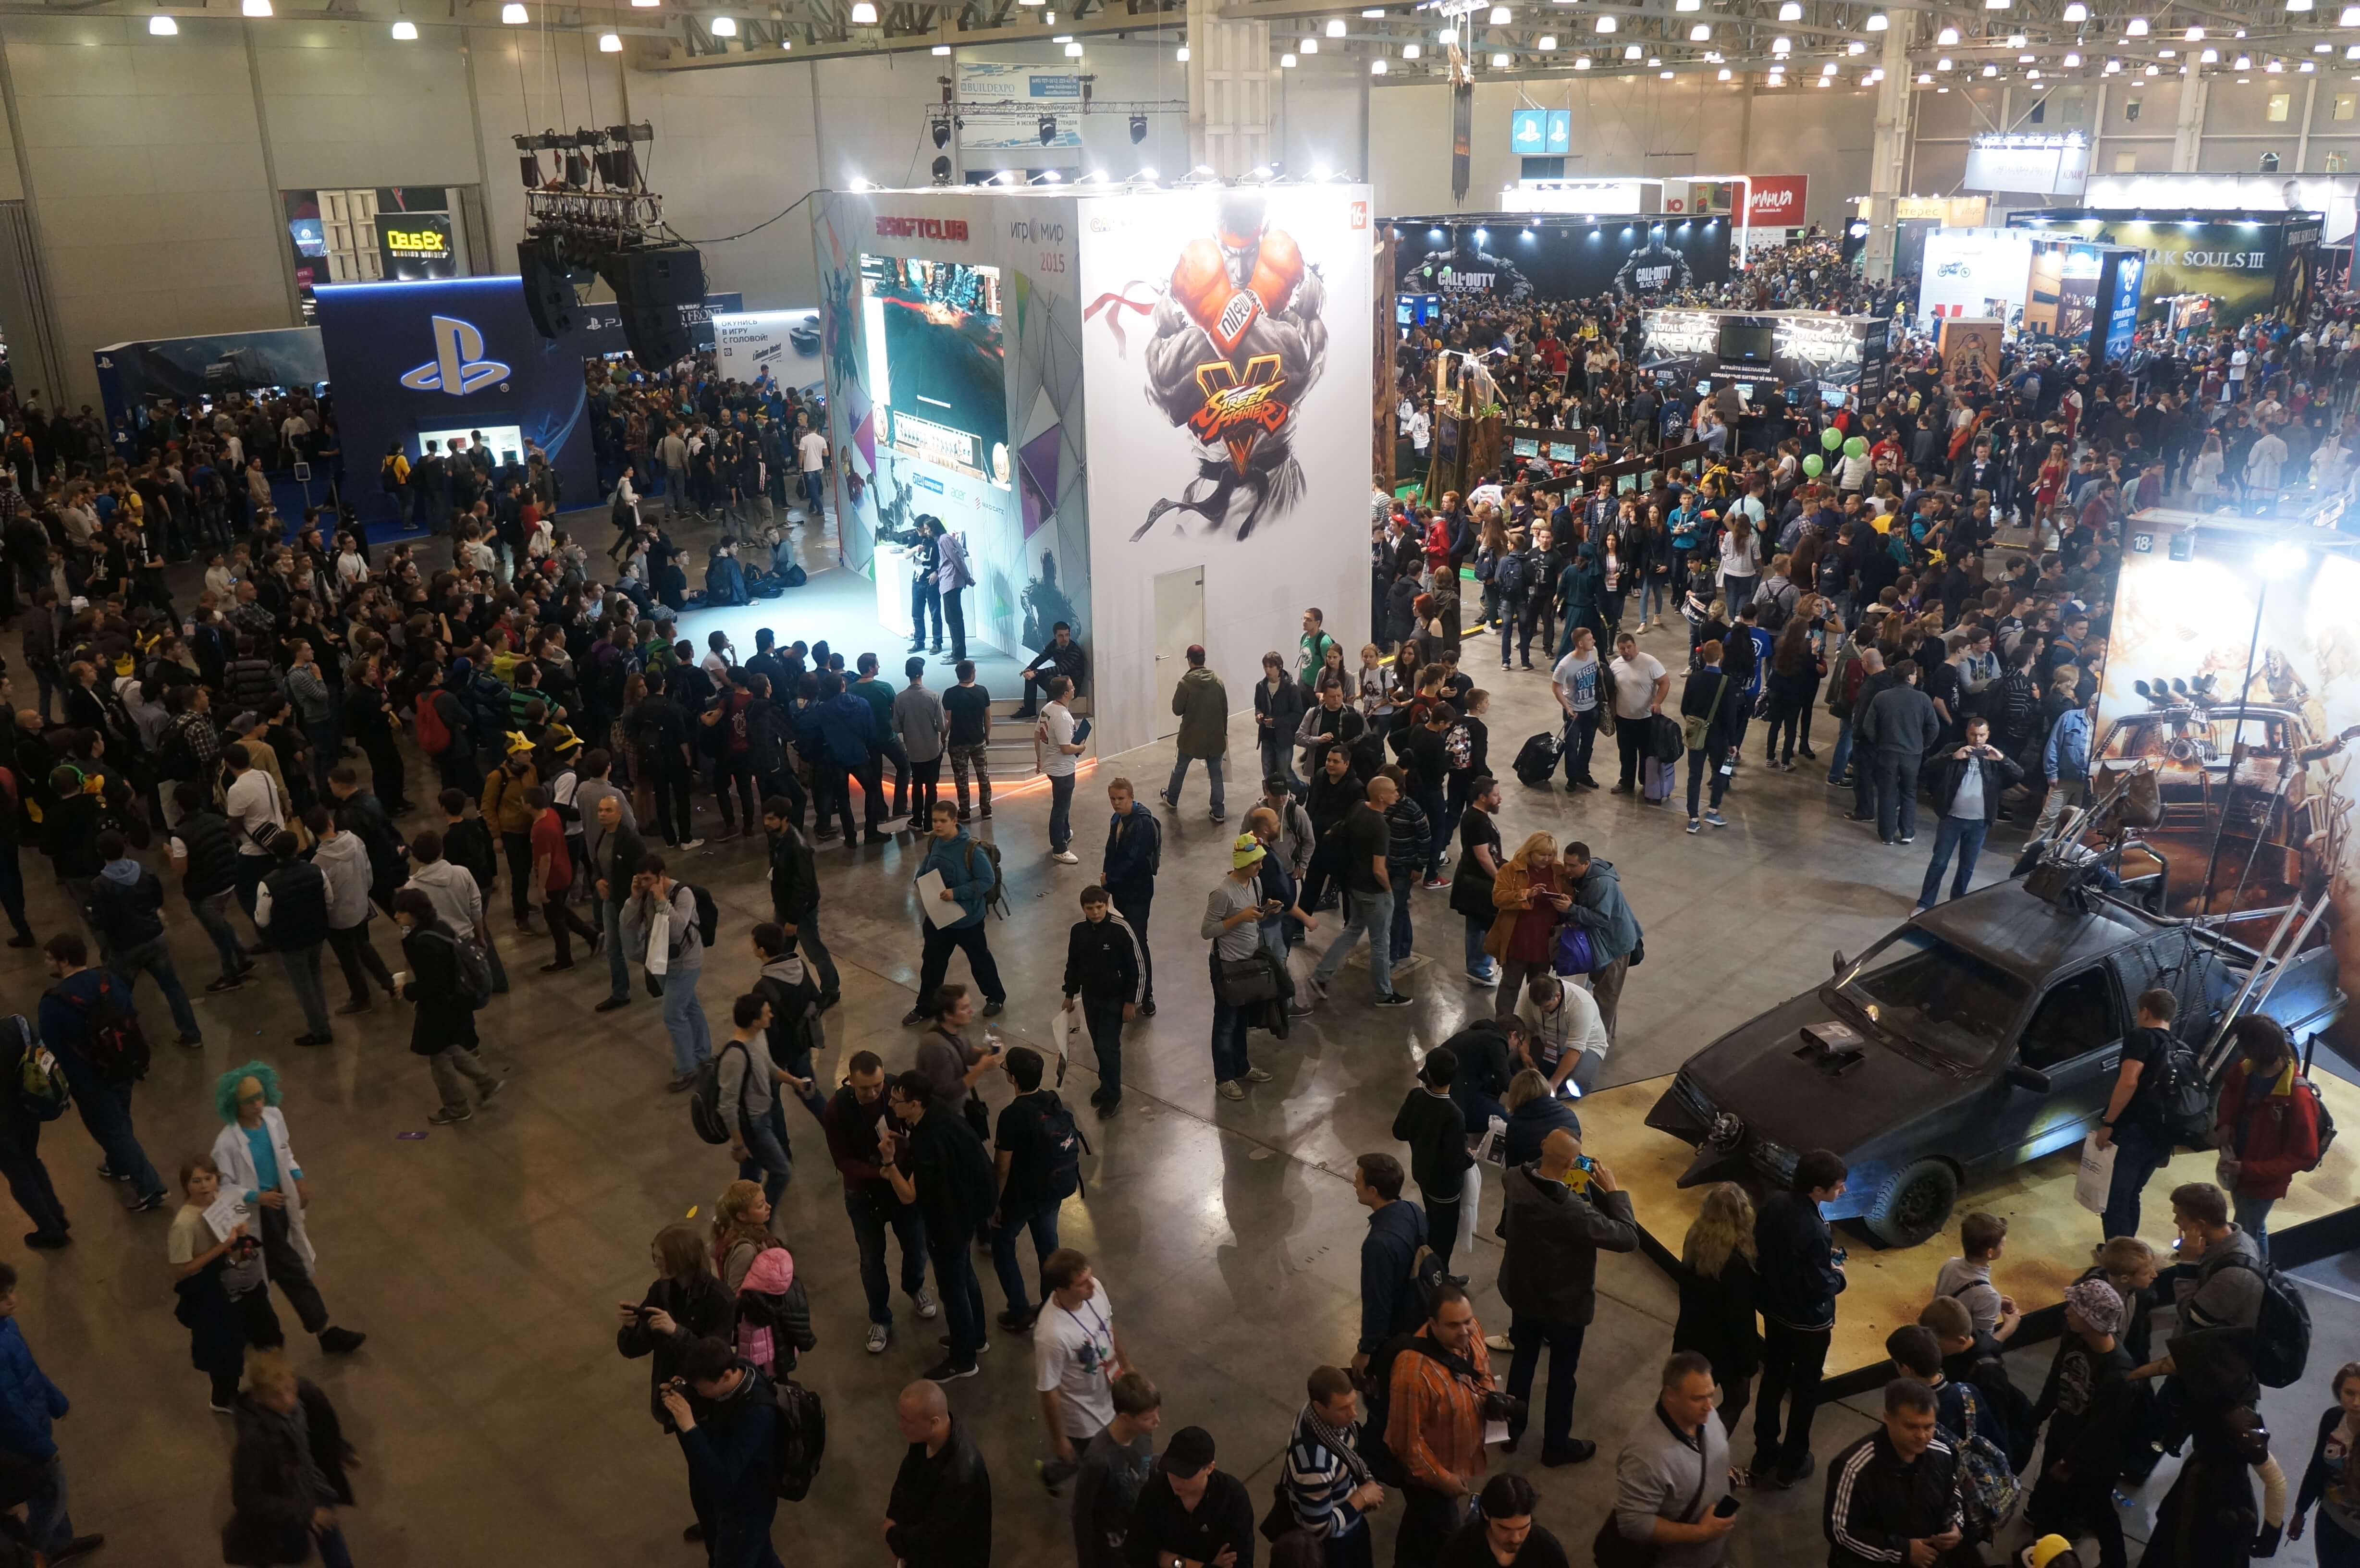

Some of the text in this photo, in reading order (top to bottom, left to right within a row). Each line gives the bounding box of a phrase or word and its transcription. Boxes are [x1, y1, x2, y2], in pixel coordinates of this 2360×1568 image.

[968, 83, 1015, 93] BUILDEXPO
[1040, 252, 1065, 273] 2015
[2182, 251, 2246, 268] SOULS
[1438, 271, 1463, 286] CALL
[1465, 273, 1496, 288] DUTY
[1636, 267, 1651, 282] CALL
[1654, 265, 1672, 280] DUTY
[722, 319, 758, 328] ОКУНИСЬ
[1653, 323, 1681, 332] TOTAL
[730, 334, 768, 343] ГОЛОВОЙ!
[1643, 332, 1717, 358] ARENA
[1821, 333, 1842, 342] WAR
[1781, 341, 1859, 368] ARENA
[1657, 370, 1674, 379] SEGA
[1203, 400, 1288, 440] FIGHTER
[951, 488, 966, 501] acer
